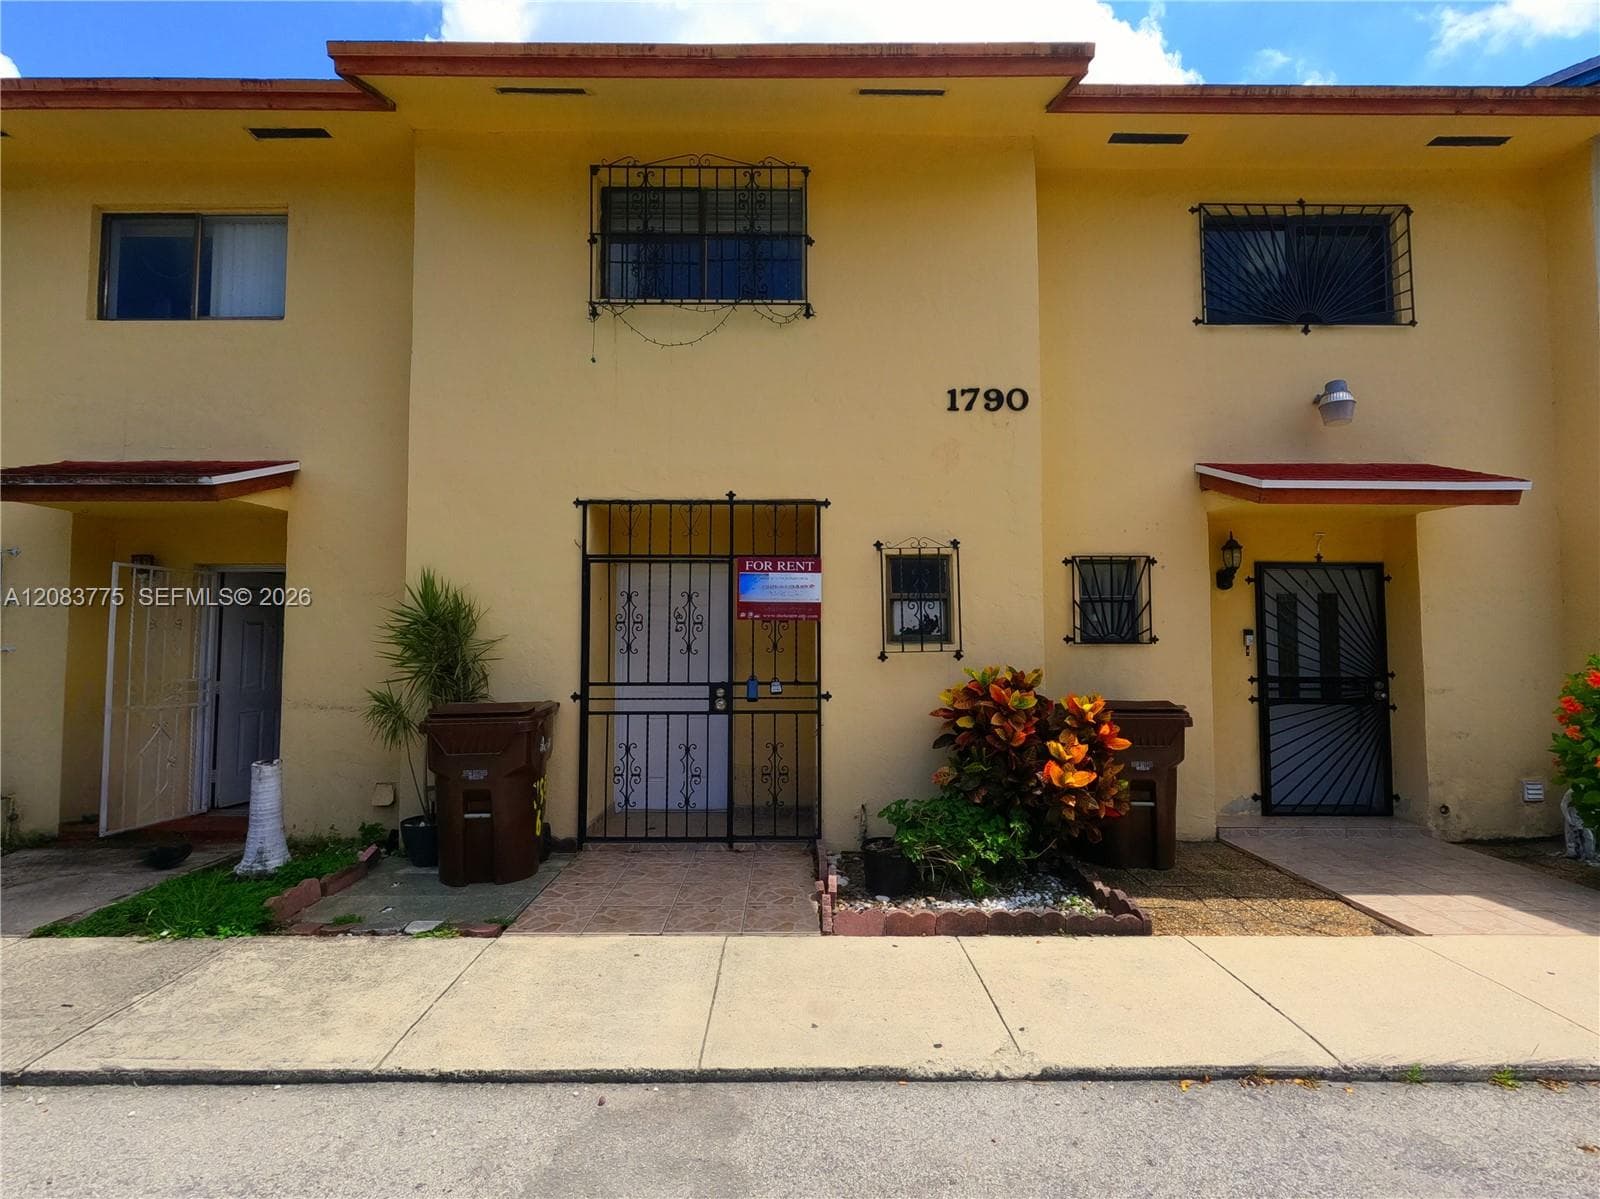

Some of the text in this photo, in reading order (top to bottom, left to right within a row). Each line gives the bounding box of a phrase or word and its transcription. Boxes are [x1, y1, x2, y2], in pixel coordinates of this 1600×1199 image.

[947, 387, 1029, 411] 1790
[745, 560, 815, 571] FOR RENT
